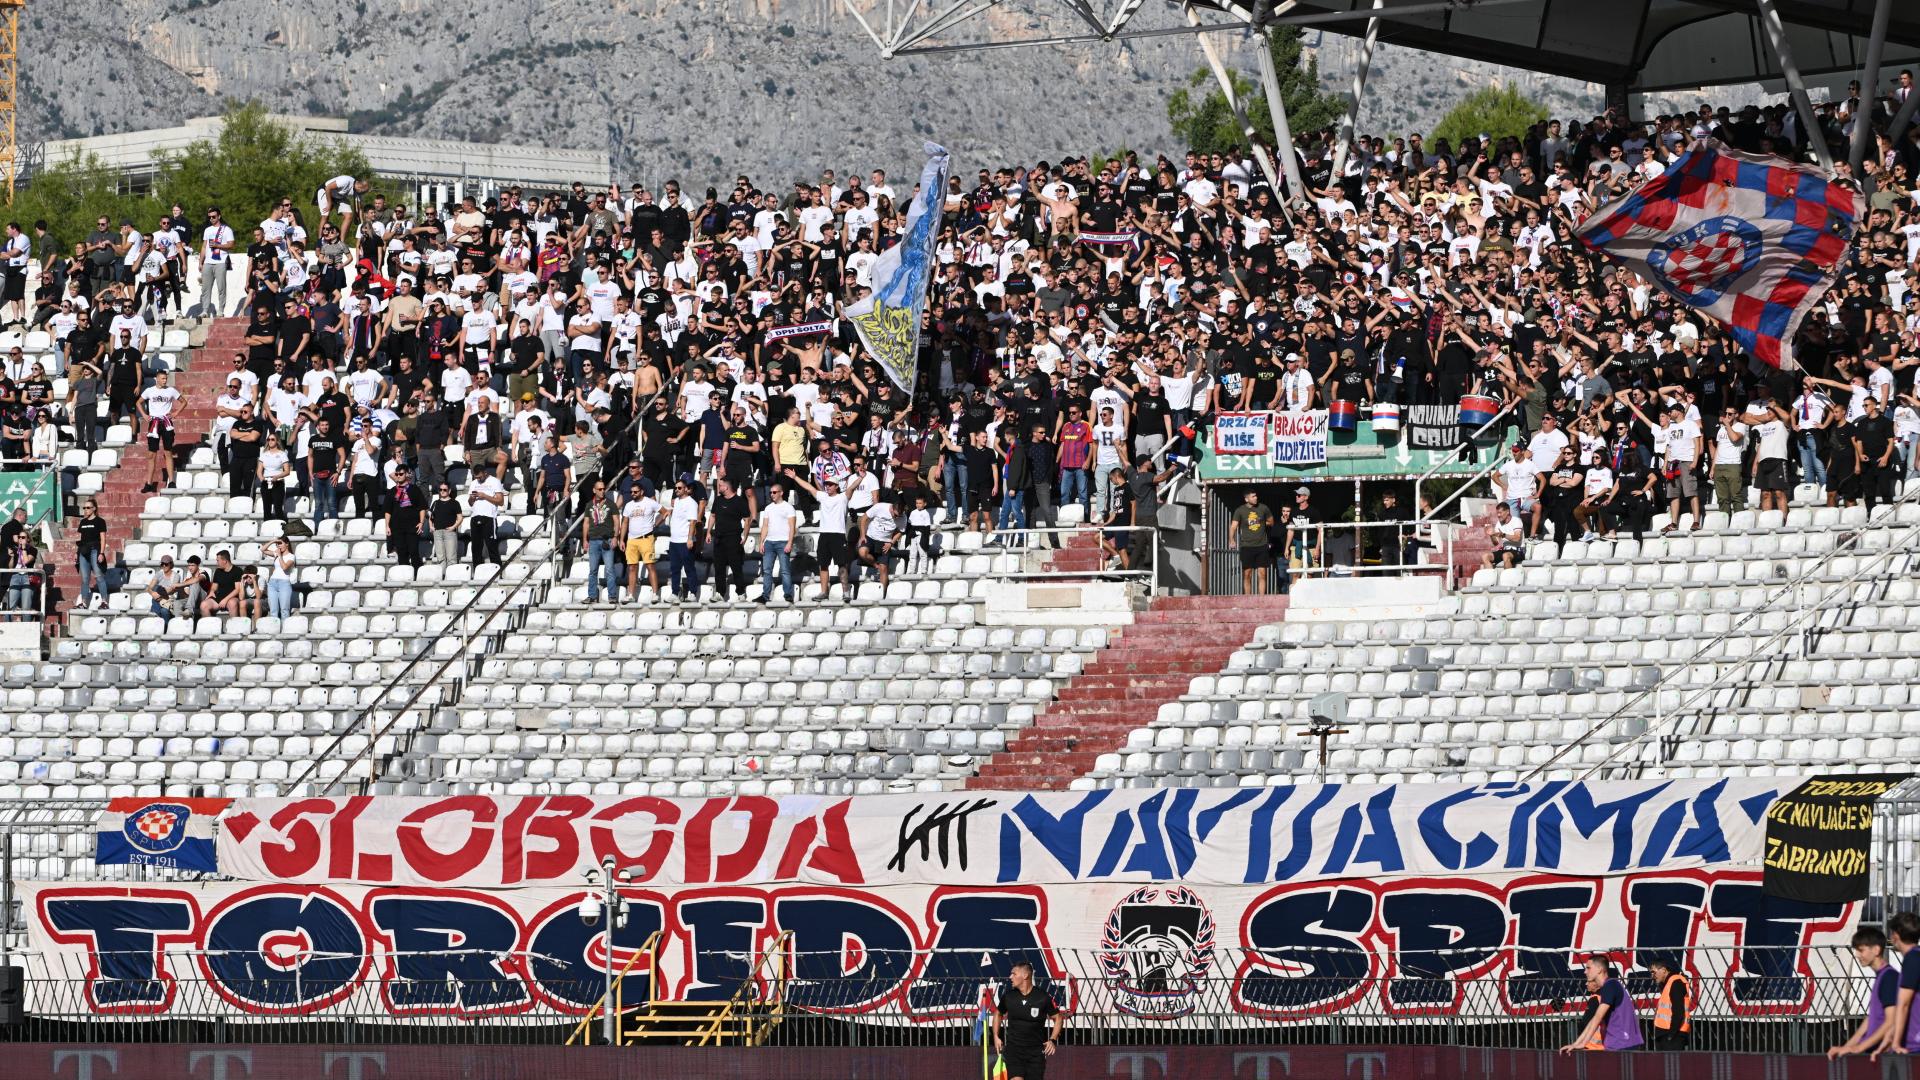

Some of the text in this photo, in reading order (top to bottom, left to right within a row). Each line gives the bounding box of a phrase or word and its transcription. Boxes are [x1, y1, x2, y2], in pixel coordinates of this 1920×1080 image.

[1250, 416, 1266, 428] SE
[1224, 431, 1255, 447] MIŠE
[1275, 439, 1325, 462] IZDRŽITE
[1789, 800, 1858, 831] NAVIJAČE
[259, 778, 1730, 884] SLOBODA NAVIJAČIMA
[155, 856, 178, 868] 1911
[1764, 836, 1867, 877] ZABRANOM
[37, 869, 1855, 1022] TORCIDA SPLIT
